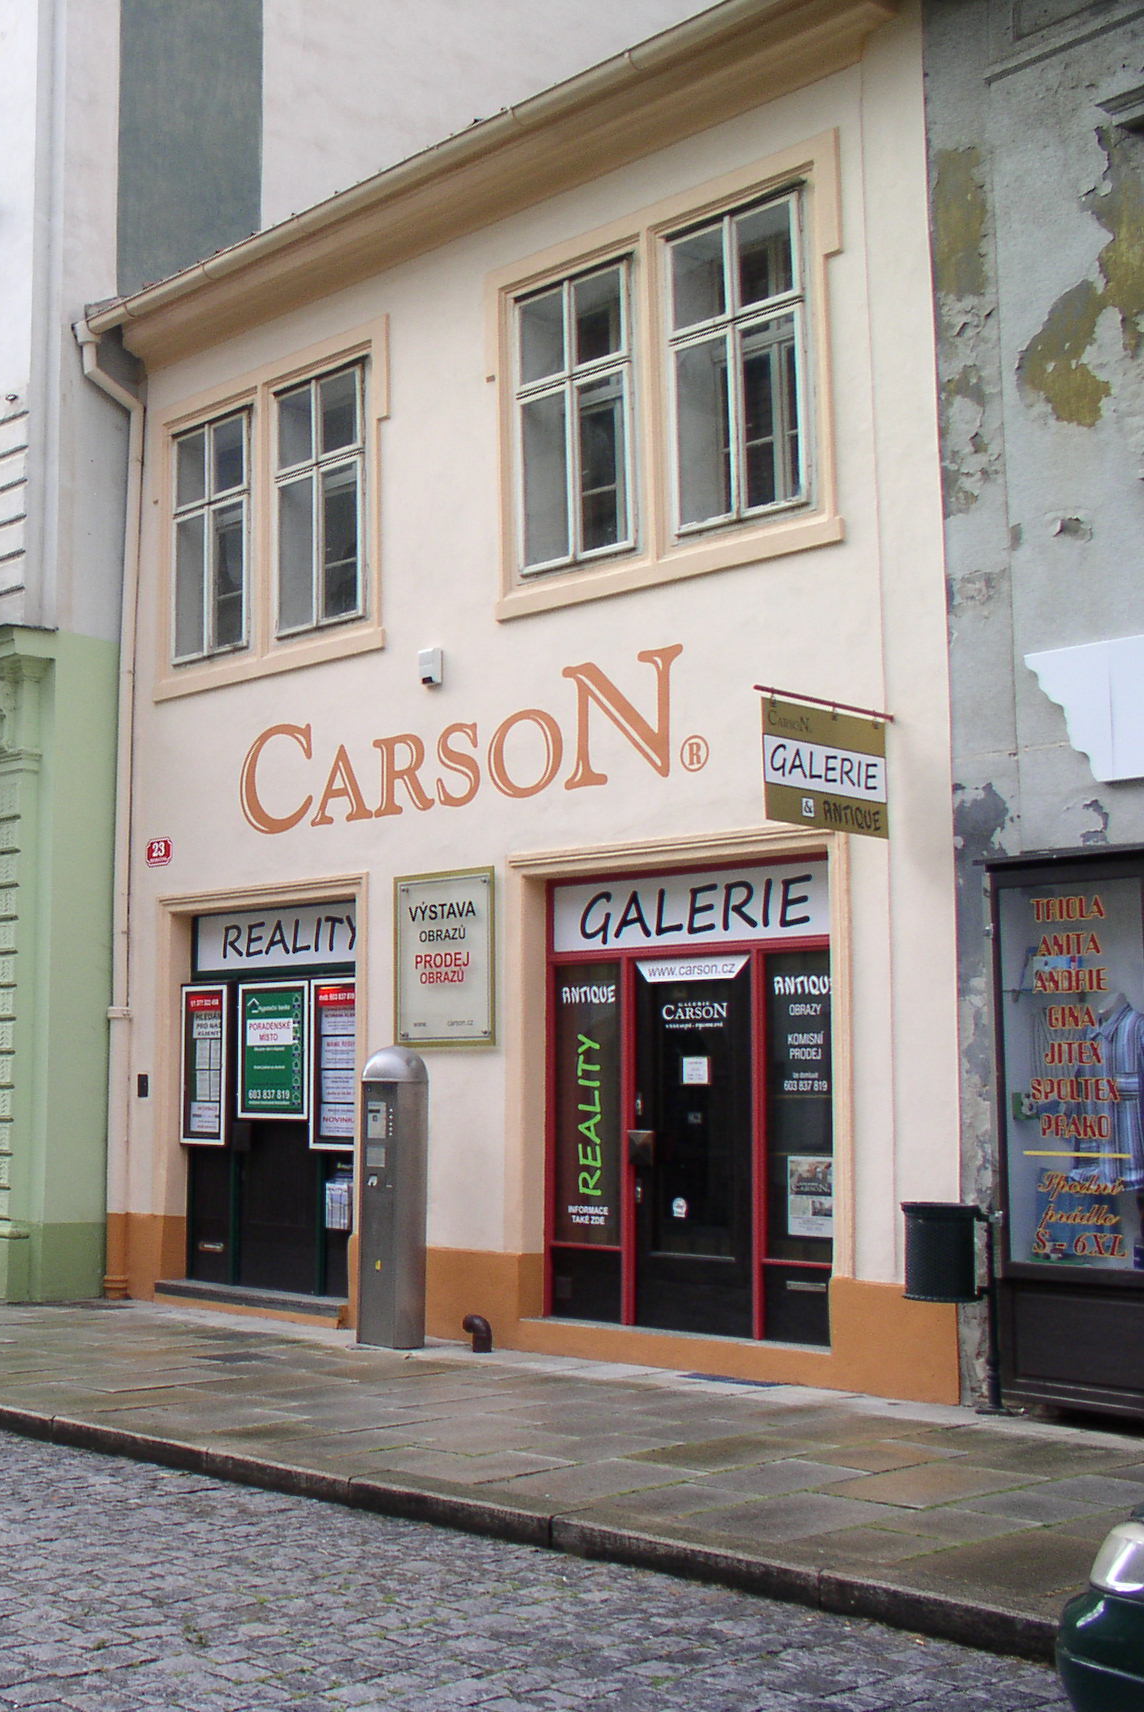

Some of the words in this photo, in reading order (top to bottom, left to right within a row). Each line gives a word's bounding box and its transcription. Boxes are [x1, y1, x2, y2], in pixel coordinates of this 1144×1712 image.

[240, 644, 683, 835] CARSON
[770, 743, 878, 790] GALERIE
[823, 800, 882, 831] ANTIQUE
[152, 841, 165, 857] 23
[408, 900, 476, 922] VÝSTAVA
[580, 873, 813, 945] GALERIE
[222, 914, 356, 959] REALITY
[419, 924, 466, 942] OBRAZŮ
[1038, 932, 1101, 957] ANITA
[415, 952, 470, 969] PRODEJ
[648, 963, 735, 977] www.carson.cz
[420, 968, 464, 984] OBRAZŮ
[562, 984, 616, 1004] ANTIQUE
[662, 1002, 728, 1020] CARSON
[789, 1004, 822, 1016] OBRAZY
[1047, 1004, 1097, 1030] GINA
[249, 1020, 290, 1030] PORADENSKÉ
[787, 1031, 824, 1045] KOMISNÍ
[789, 1048, 822, 1060] PRODEJ
[1044, 1041, 1104, 1066] JITEX
[1031, 1077, 1121, 1102] SPOLTEX
[577, 1033, 602, 1196] REALITY
[568, 1205, 609, 1215] INFORMACE
[1073, 1232, 1129, 1258] 6XL
